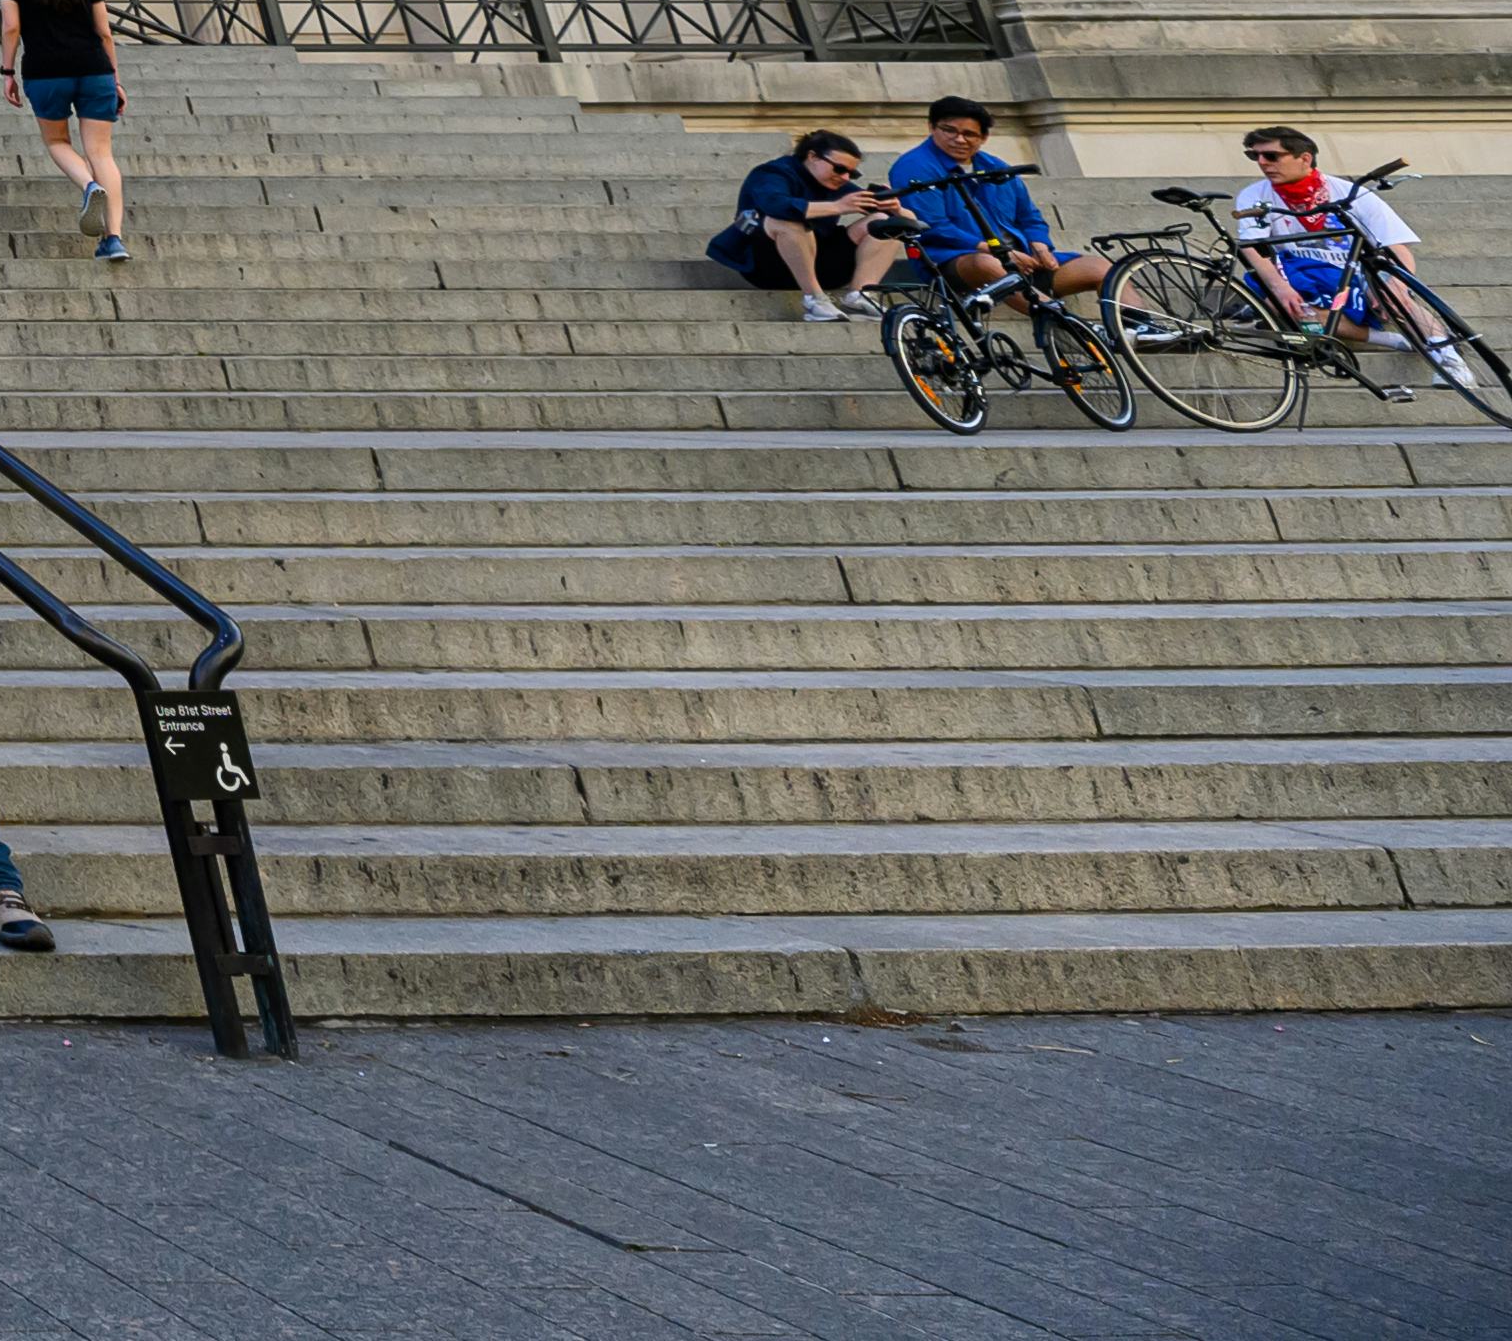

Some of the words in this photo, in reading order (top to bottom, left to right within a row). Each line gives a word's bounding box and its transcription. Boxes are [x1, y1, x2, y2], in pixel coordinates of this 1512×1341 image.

[155, 705, 176, 716] Use
[178, 705, 199, 716] 81st
[200, 705, 232, 716] Street
[158, 720, 205, 732] Entrance
